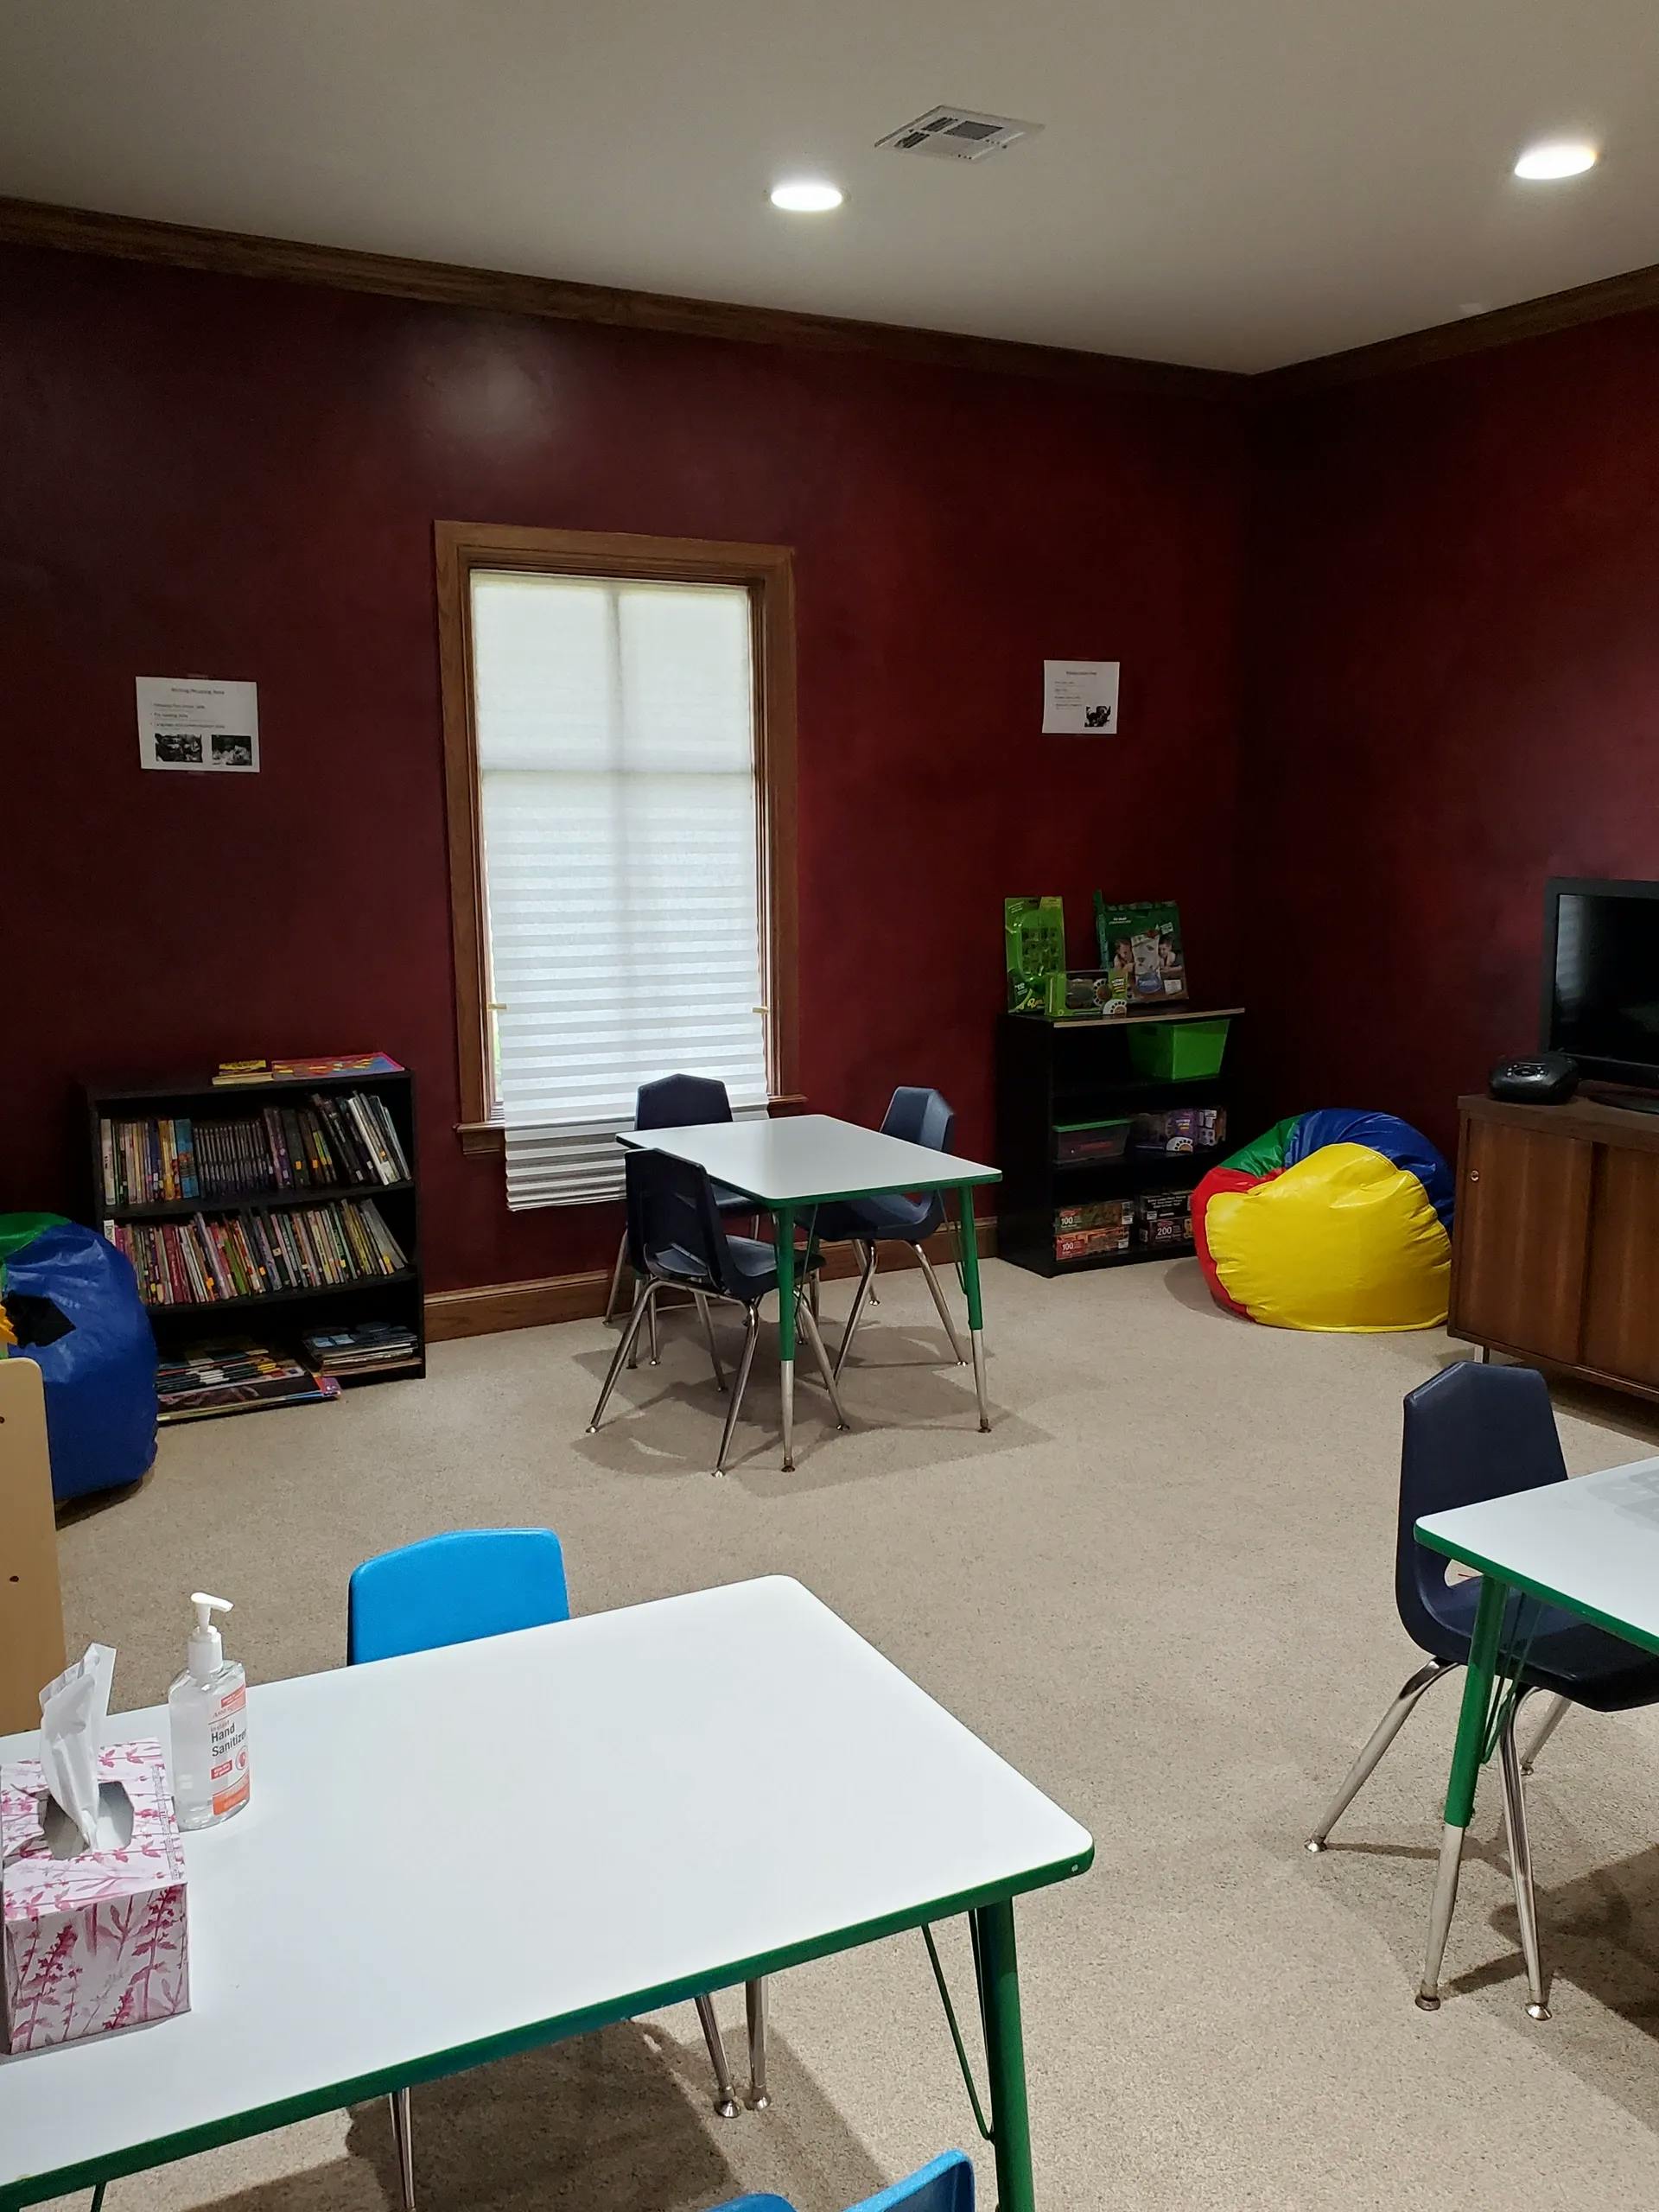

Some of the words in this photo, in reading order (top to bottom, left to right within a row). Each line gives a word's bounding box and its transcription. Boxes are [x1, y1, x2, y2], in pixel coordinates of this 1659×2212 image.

[1061, 1216, 1074, 1226] 100
[1157, 1226, 1172, 1236] 200
[1062, 1242, 1074, 1251] 100
[211, 1722, 235, 1744] Hand
